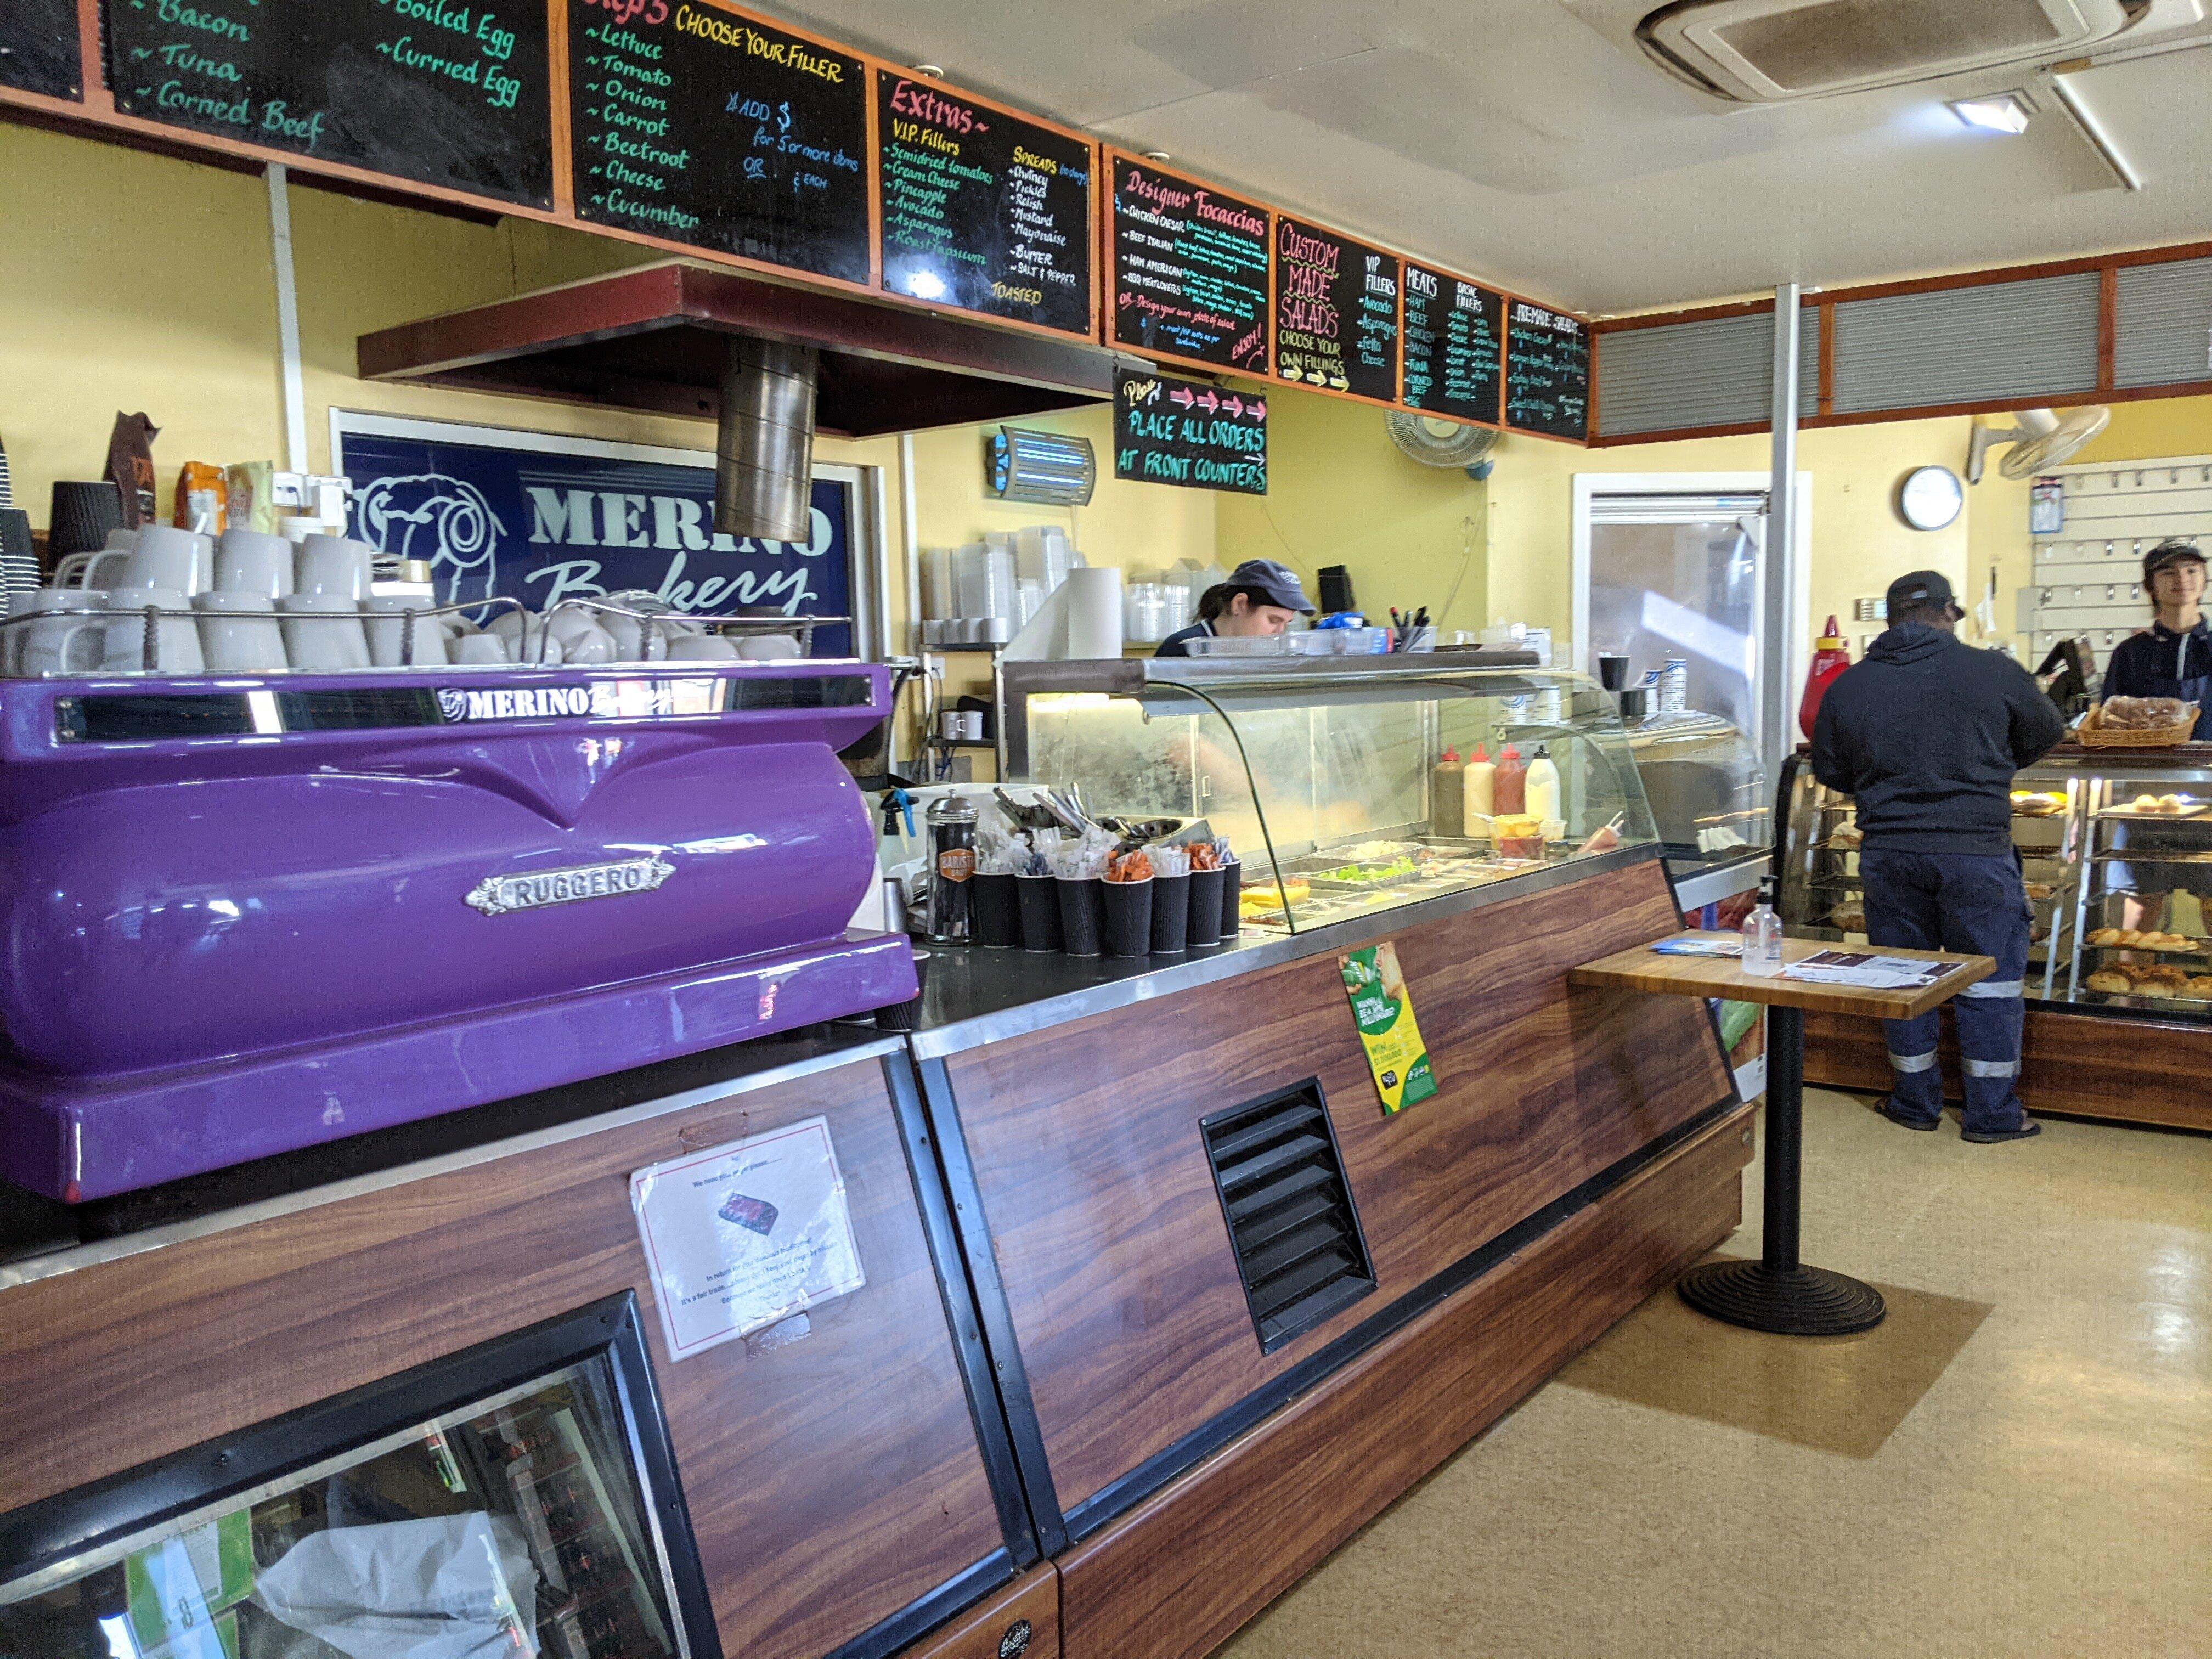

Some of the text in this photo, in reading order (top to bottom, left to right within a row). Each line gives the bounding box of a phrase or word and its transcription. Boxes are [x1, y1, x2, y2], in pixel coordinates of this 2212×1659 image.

[158, 0, 250, 42] Bacon
[476, 14, 515, 60] Egg
[601, 24, 663, 60] Lettuce
[676, 4, 745, 48] CHOOSE
[745, 27, 788, 65] YOUR
[786, 46, 844, 83] FILLER
[159, 44, 243, 82] Tuna
[393, 36, 521, 108] Curried Egg
[603, 55, 672, 86] Tomato
[605, 80, 667, 111] Onion
[739, 99, 769, 121] ADD
[890, 80, 973, 134] Extras
[157, 80, 325, 151] Corned Beef
[603, 103, 670, 136] Carrot
[604, 132, 691, 170] Beetroot
[754, 126, 774, 146] for
[788, 143, 803, 154] or
[802, 146, 830, 163] more
[891, 142, 947, 170] Semidried
[921, 128, 960, 156] Fillers
[606, 160, 667, 191] Cheese
[743, 156, 764, 173] OR
[892, 160, 960, 190] Cream Cheese
[1014, 165, 1048, 189] Chutney
[803, 173, 828, 189] EACH
[894, 178, 947, 206] Pineapple
[1015, 180, 1047, 198] Pickles
[608, 188, 699, 229] Cucumber
[895, 195, 944, 219] Avocado
[1015, 193, 1043, 211] Relish
[1015, 207, 1053, 227] Mustard
[1126, 170, 1191, 215] Designer
[1194, 190, 1263, 236] Focaccias
[1128, 205, 1160, 224] CHICKEN
[894, 212, 953, 240] Asparagus
[1129, 230, 1173, 252] BEEF ITALIAN
[1280, 223, 1339, 272] CUSTOM
[1018, 262, 1039, 277] SALT
[1047, 269, 1076, 286] PEPPER
[1129, 253, 1145, 268] HAM
[1146, 260, 1183, 278] AMERICAN
[1365, 256, 1380, 272] VIP
[991, 281, 1042, 306] TOASTED
[1289, 264, 1334, 302] MADE
[1366, 274, 1395, 296] FILLERS
[1407, 267, 1437, 297] MEATS
[1457, 281, 1477, 298] BASIC
[1137, 294, 1159, 316] Design
[1159, 305, 1176, 319] your
[1280, 297, 1339, 338] SALADS
[1410, 310, 1429, 327] BEEF
[1456, 295, 1482, 312] FILLERS
[1280, 330, 1341, 358] CHOOSE YOUR
[1280, 353, 1345, 375] OWN FILLINGS
[1128, 410, 1265, 452] PLACE ALL ORDERS
[1117, 448, 1266, 490] AT FRONT COUNTERS
[526, 486, 833, 556] MERO
[525, 551, 817, 617] Bkery
[466, 687, 591, 719] MERINO
[515, 865, 641, 906] RUGGERO
